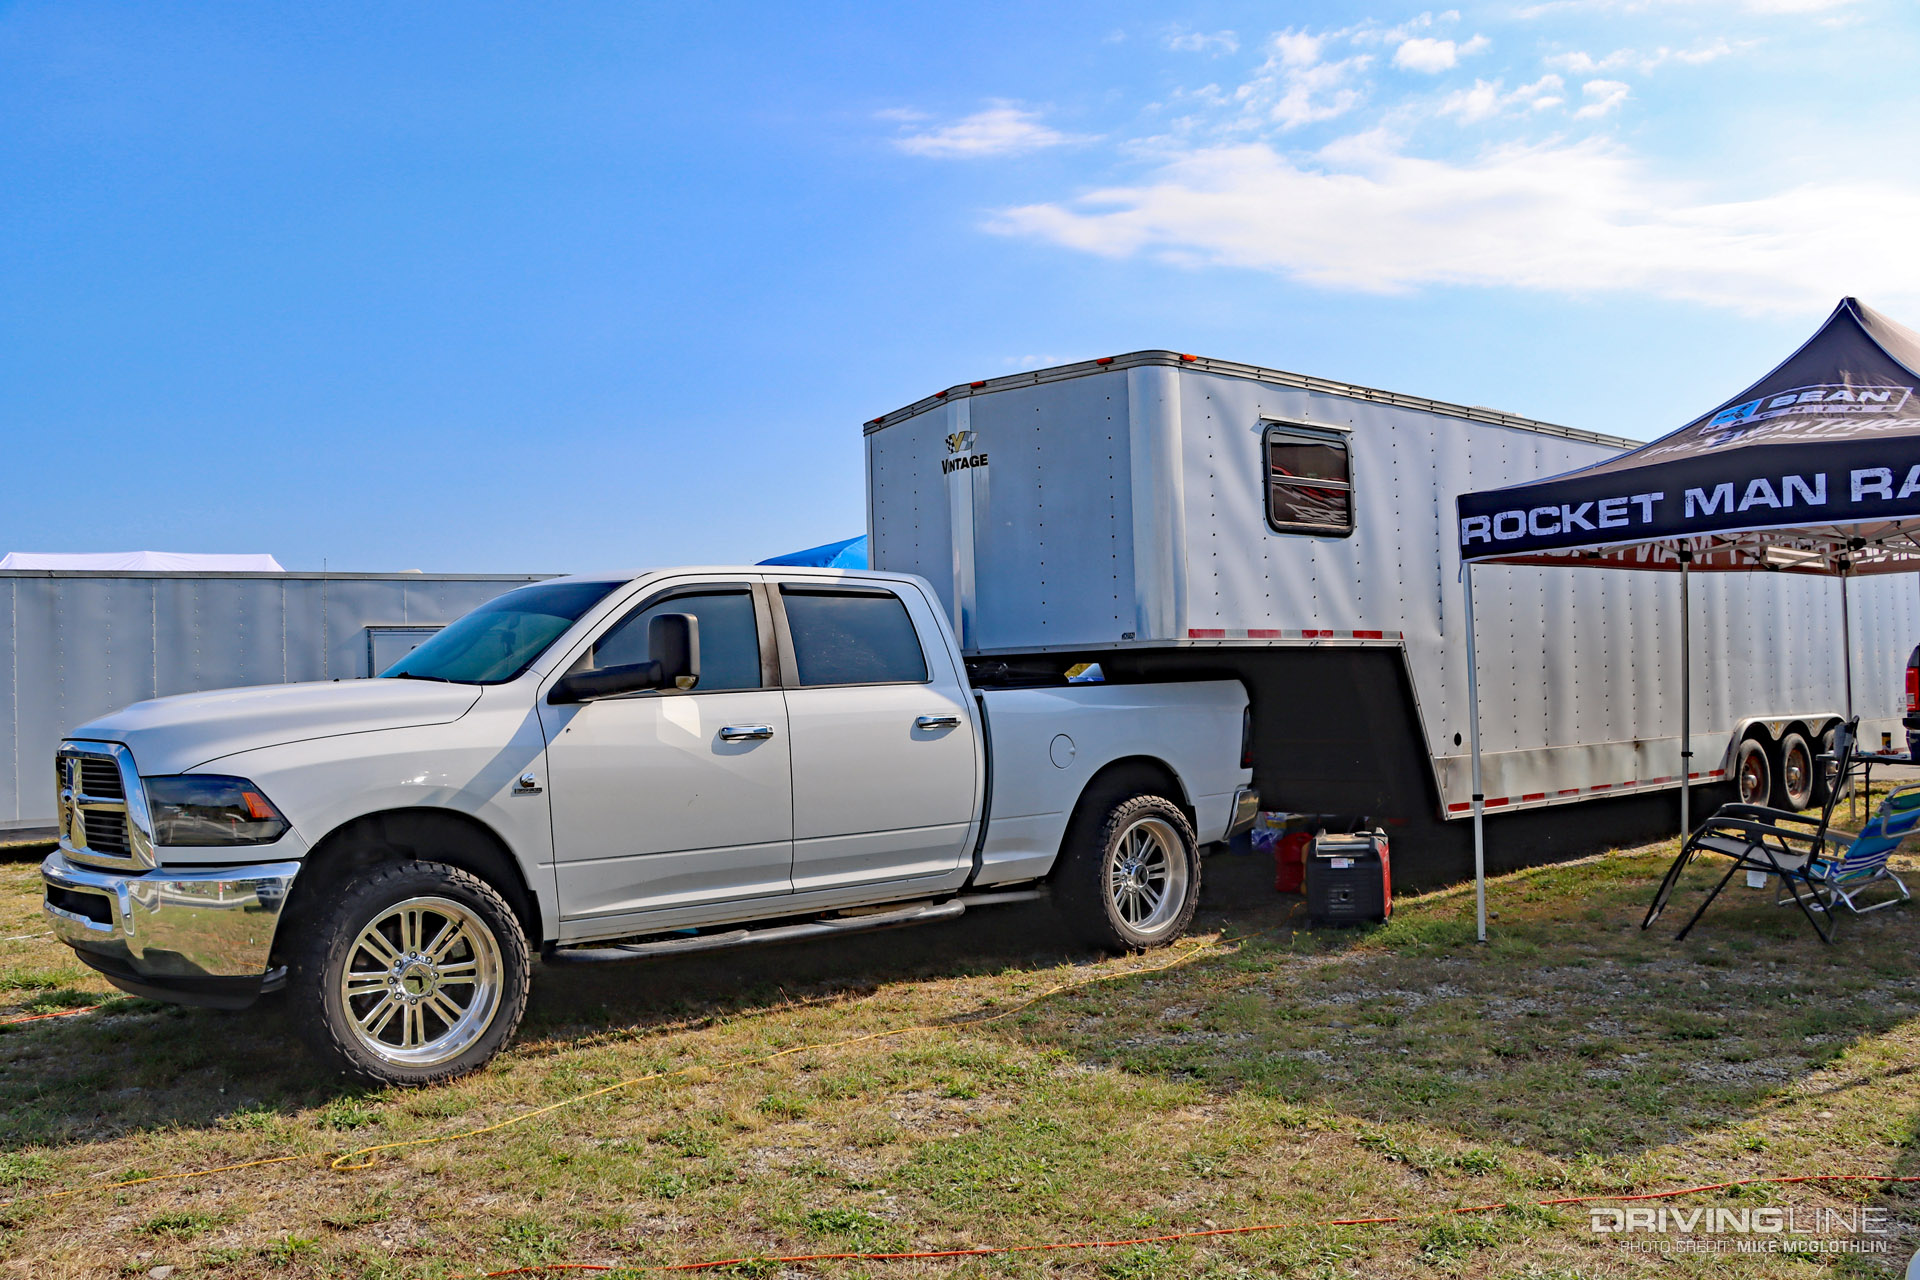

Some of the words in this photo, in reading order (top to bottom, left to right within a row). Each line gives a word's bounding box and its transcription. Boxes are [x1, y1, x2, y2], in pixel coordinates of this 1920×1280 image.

[1768, 389, 1892, 409] BEAN
[941, 453, 989, 475] VINTAGE
[1461, 491, 1664, 546] ROCKET
[1684, 472, 1827, 518] MAN
